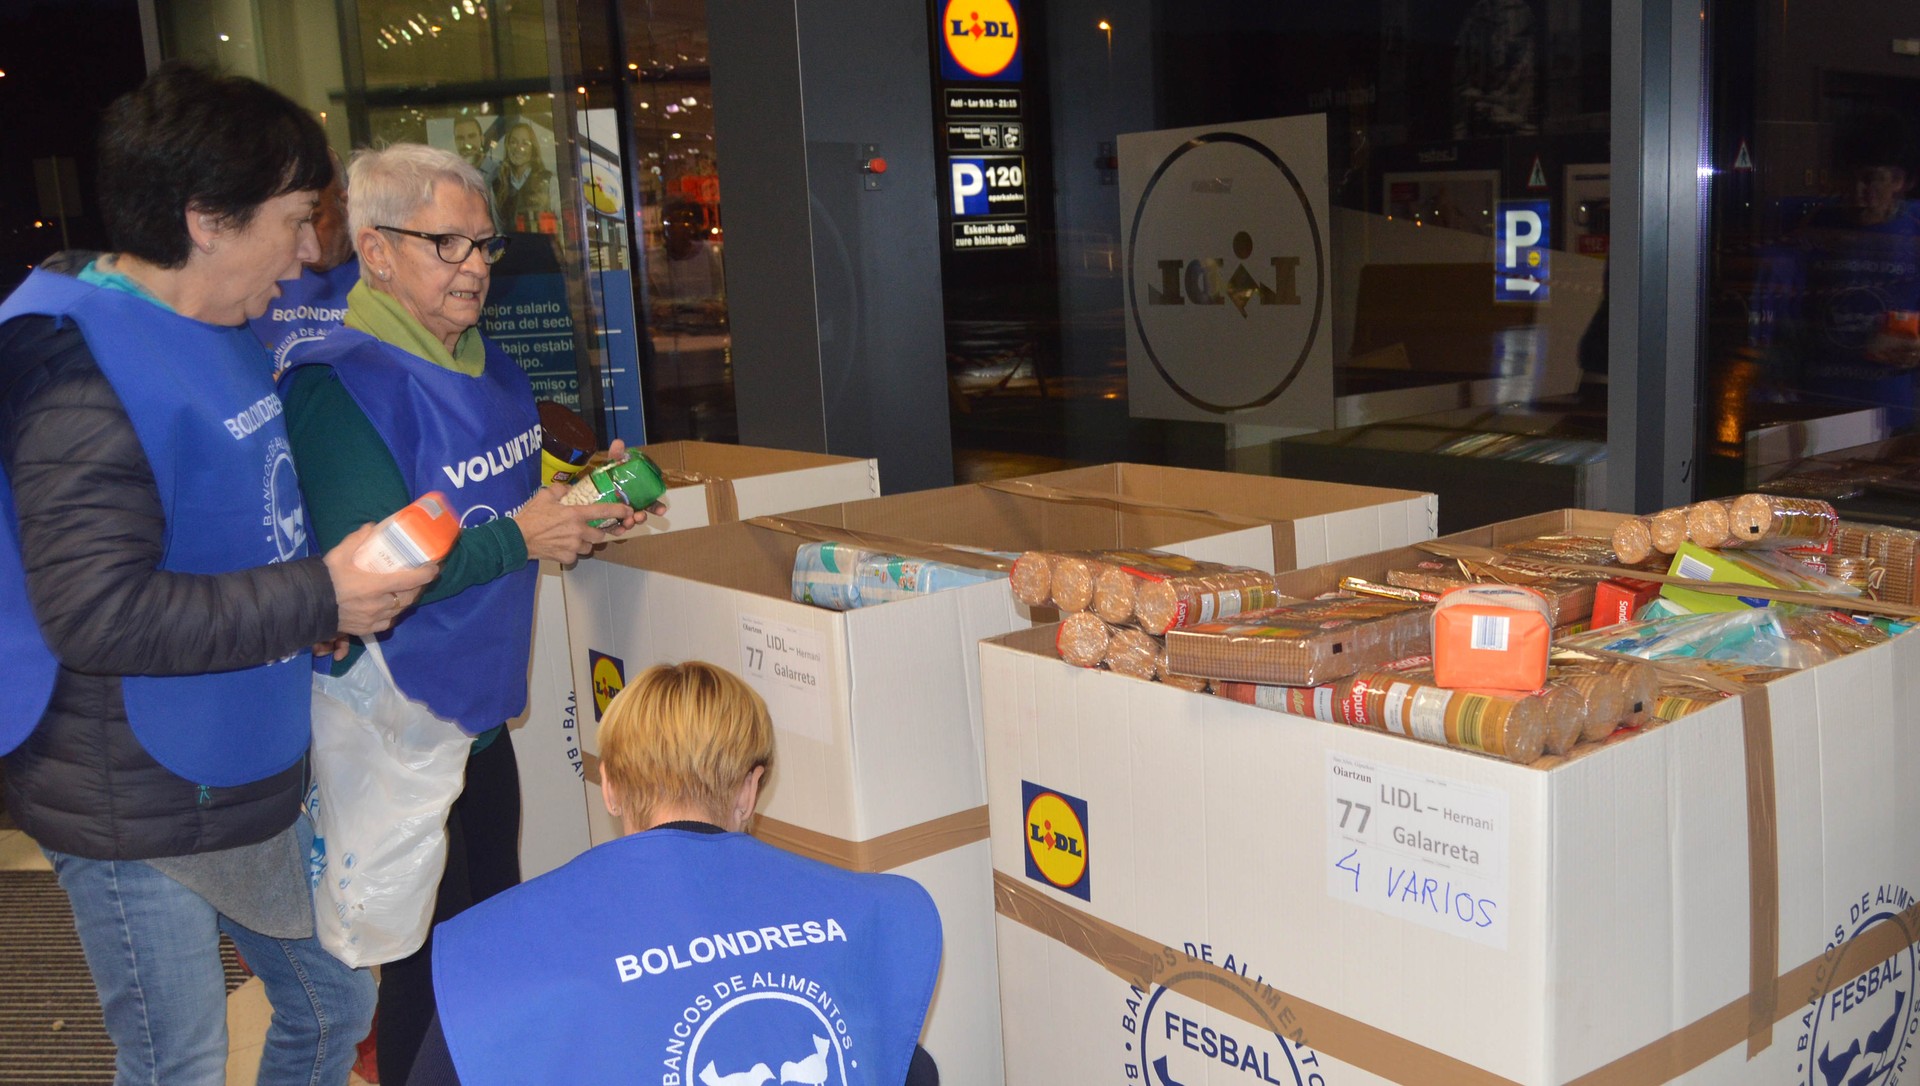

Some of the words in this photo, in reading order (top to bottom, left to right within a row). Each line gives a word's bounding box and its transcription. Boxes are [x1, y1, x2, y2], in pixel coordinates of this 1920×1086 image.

[952, 163, 983, 215] P
[985, 165, 1023, 187] 120
[963, 224, 996, 235] Eskerrik
[997, 223, 1016, 234] asko
[1505, 210, 1542, 268] P
[486, 319, 516, 331] hora
[519, 317, 539, 329] del
[516, 302, 560, 315] salario
[500, 342, 530, 356] bajo
[533, 338, 574, 351] establ
[746, 646, 764, 671] 77
[766, 633, 788, 653] LIDL
[774, 663, 816, 686] Galarreta
[1332, 765, 1373, 784] Oiartzun
[1336, 798, 1373, 834] 77
[1380, 783, 1424, 814] LIDL
[1443, 807, 1495, 832] Hernani
[1392, 825, 1481, 865] Galarreta
[1387, 866, 1497, 928] VARIOS
[615, 918, 848, 983] BOLONDRESA
[1797, 924, 1845, 1052] BANCOS
[1850, 892, 1870, 925] DE
[1831, 953, 1903, 1023] FESBAL
[663, 994, 713, 1086] BANCOS
[713, 975, 747, 999] DE
[752, 972, 853, 1050] ALIMENTOS
[1183, 942, 1214, 965] DE
[1223, 953, 1326, 1086] ALIMENTO
[1164, 1010, 1281, 1086] FESBAL
